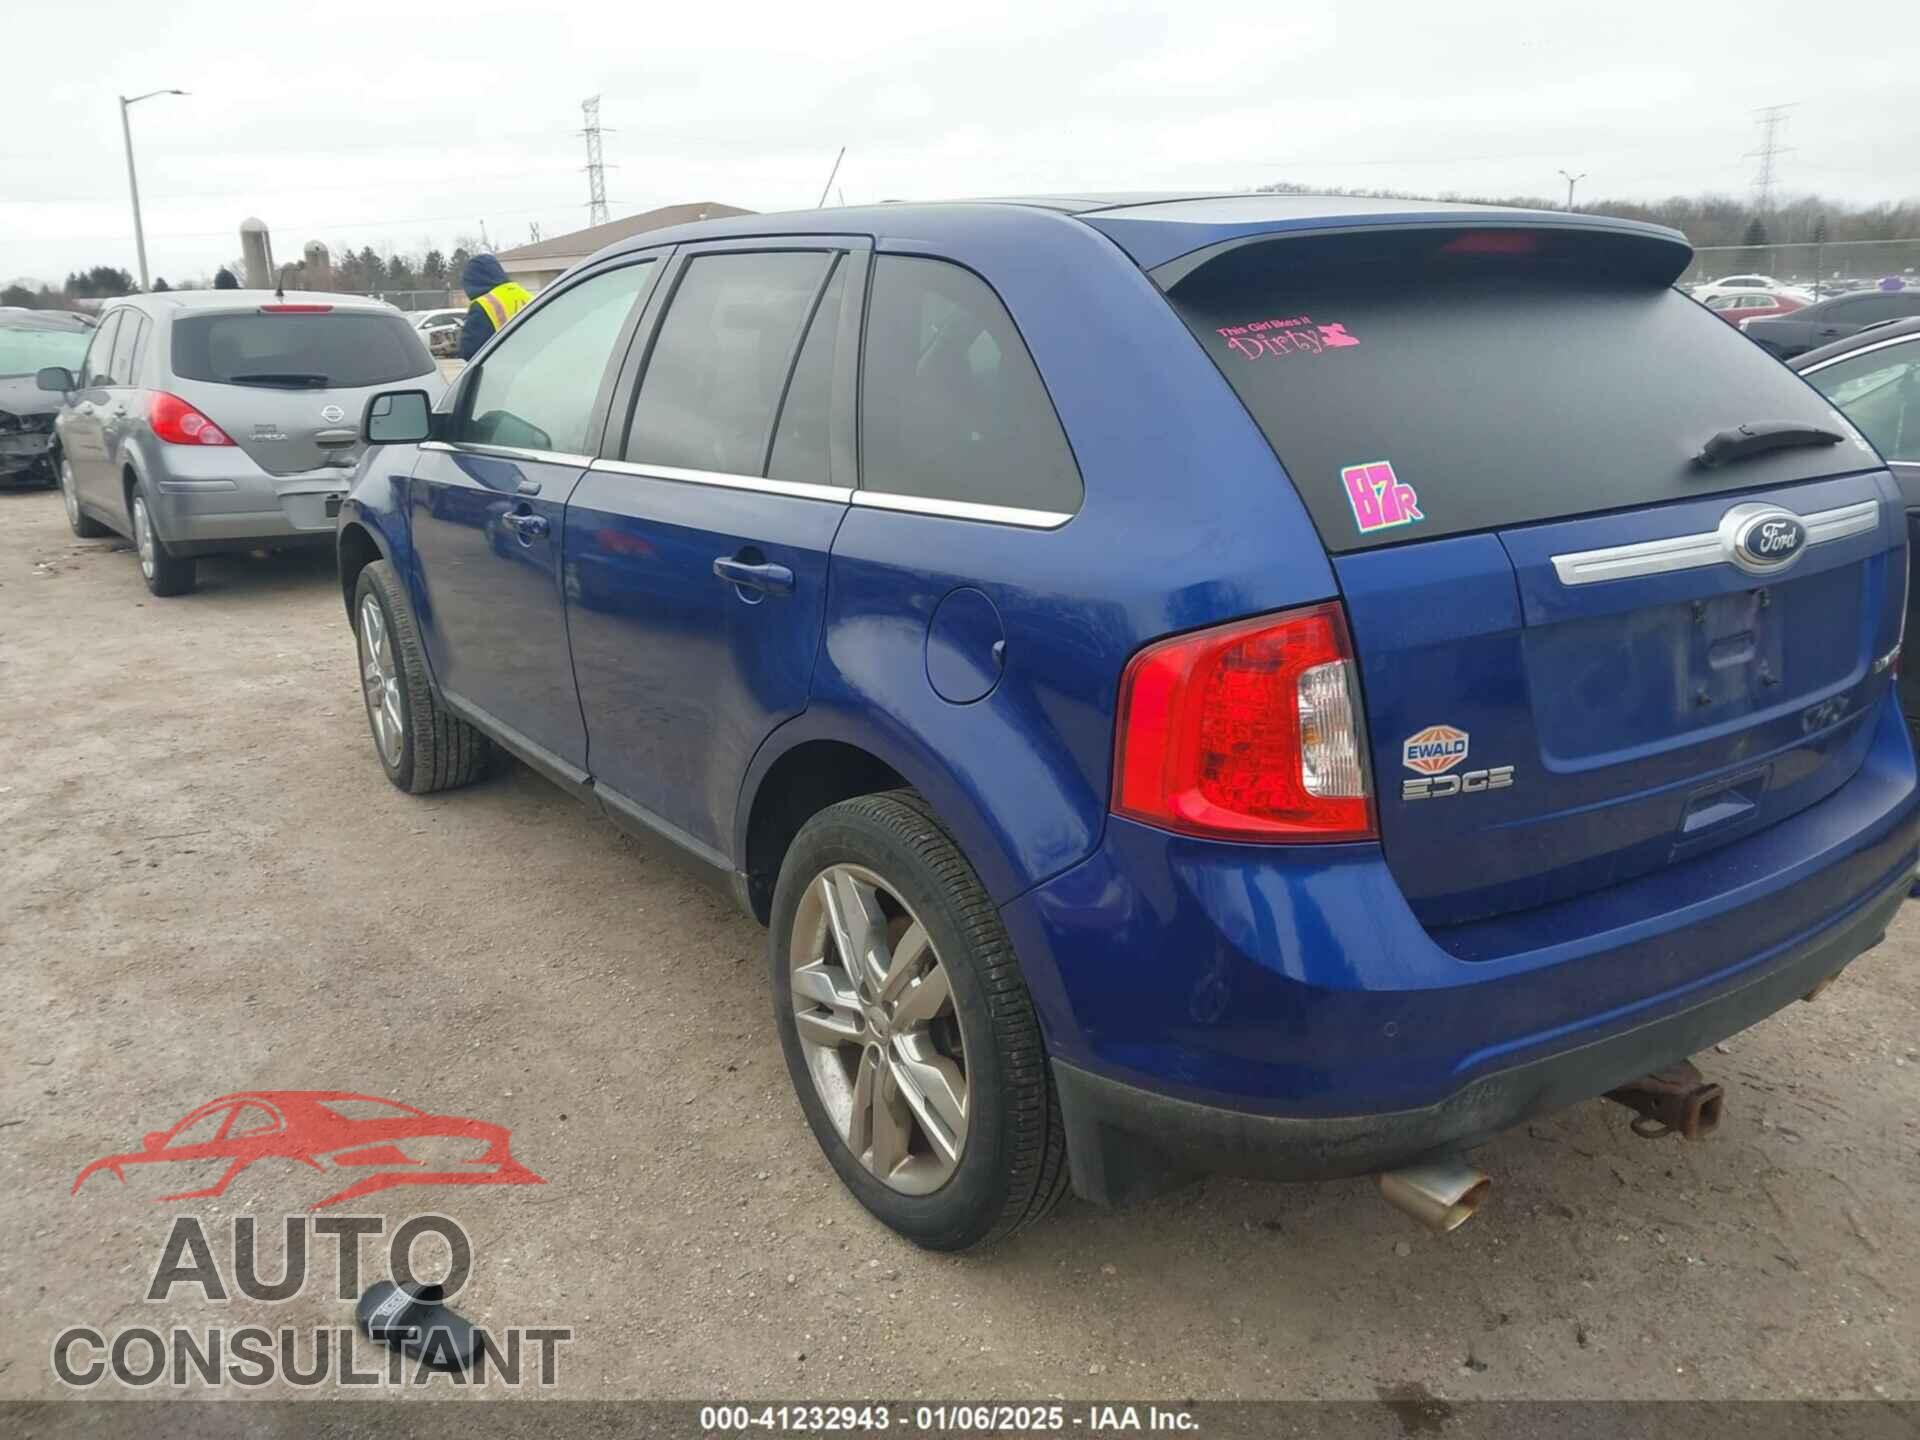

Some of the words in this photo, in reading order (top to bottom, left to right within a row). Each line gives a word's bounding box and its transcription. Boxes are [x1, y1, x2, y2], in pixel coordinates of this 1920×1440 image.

[1216, 327, 1248, 338] This
[1248, 319, 1271, 332] Girl
[1227, 328, 1322, 361] Dirty
[1760, 521, 1798, 553] Ford
[1407, 739, 1466, 760] EWALD
[1402, 765, 1515, 801] EDGE
